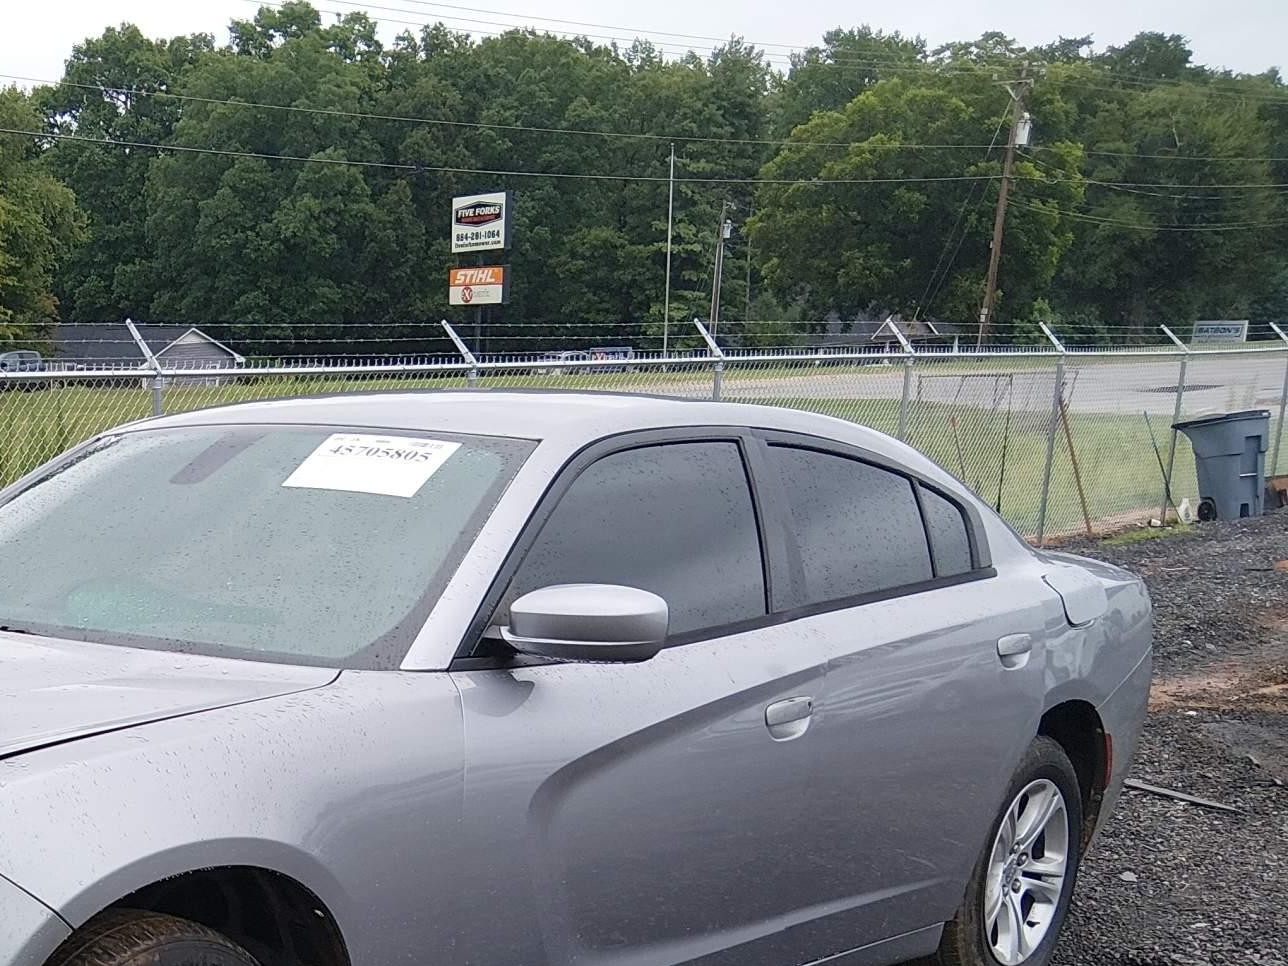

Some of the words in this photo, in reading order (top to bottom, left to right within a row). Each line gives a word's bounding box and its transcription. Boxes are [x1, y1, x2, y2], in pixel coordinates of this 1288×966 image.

[458, 208, 474, 218] FIVE
[475, 206, 500, 216] FORKS
[455, 270, 495, 284] STIHL
[329, 445, 432, 462] 45705805
